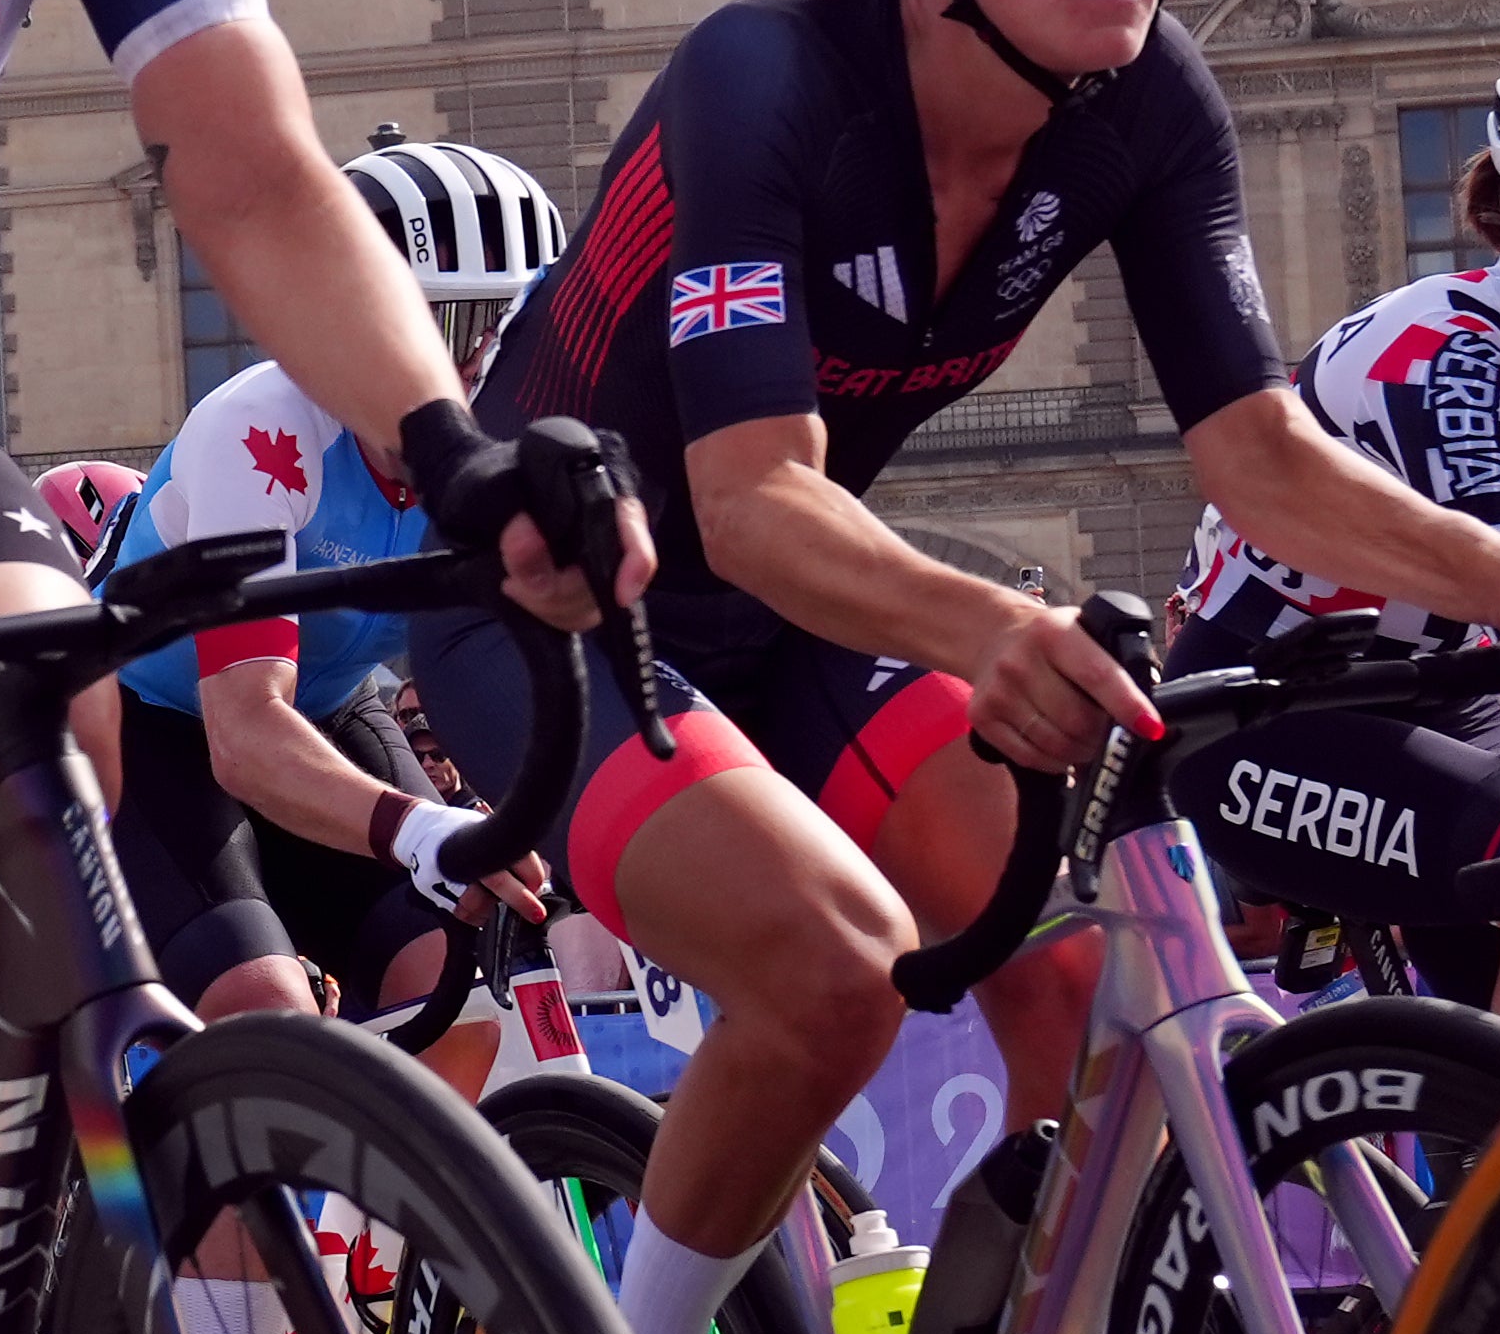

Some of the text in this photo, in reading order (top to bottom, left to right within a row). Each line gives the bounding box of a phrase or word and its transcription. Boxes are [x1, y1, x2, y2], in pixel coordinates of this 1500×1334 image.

[1074, 725, 1134, 862] SRAM
[1219, 759, 1420, 878] SERBIA
[61, 804, 123, 950] CANYON
